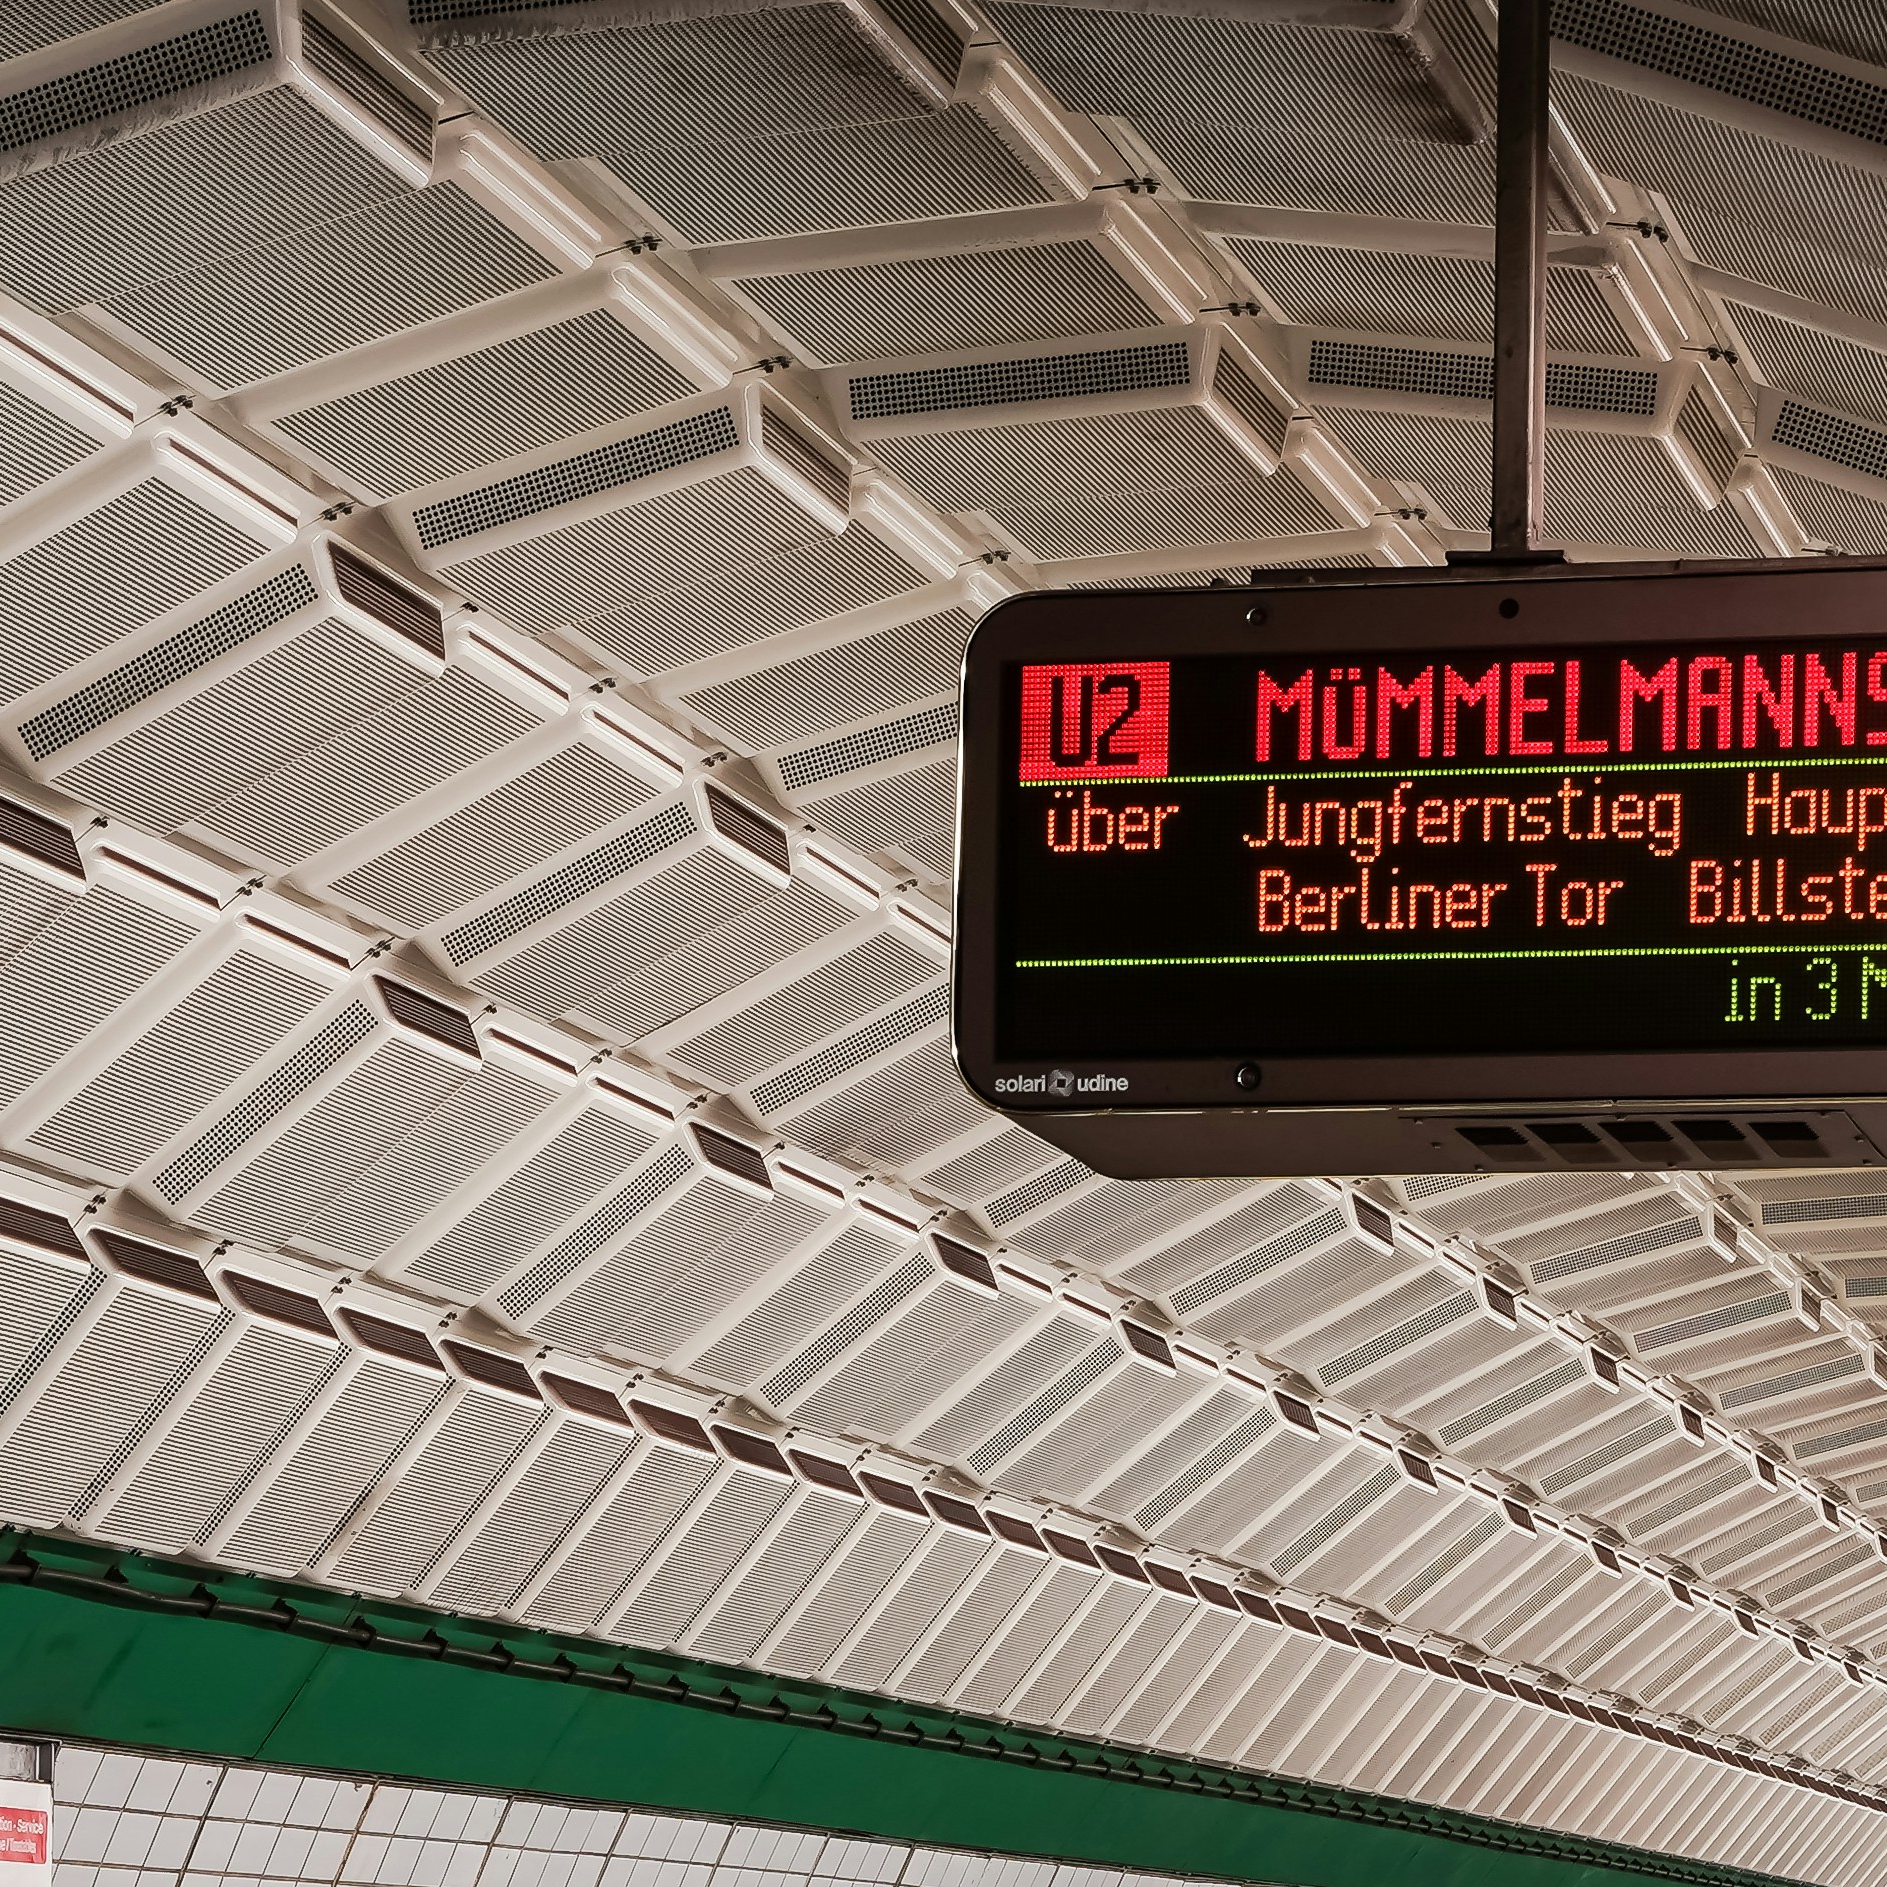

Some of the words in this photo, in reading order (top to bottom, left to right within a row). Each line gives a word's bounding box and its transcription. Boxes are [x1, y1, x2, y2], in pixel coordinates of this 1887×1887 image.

[1046, 790, 1180, 852] über
[1242, 775, 1682, 864] Jungfernstieg
[1258, 866, 1509, 933] Berliner
[1524, 863, 1626, 927] Tor
[1723, 957, 1782, 1022] in
[1805, 956, 1838, 1021] 3
[994, 1075, 1046, 1093] solari
[1077, 1074, 1129, 1092] udine
